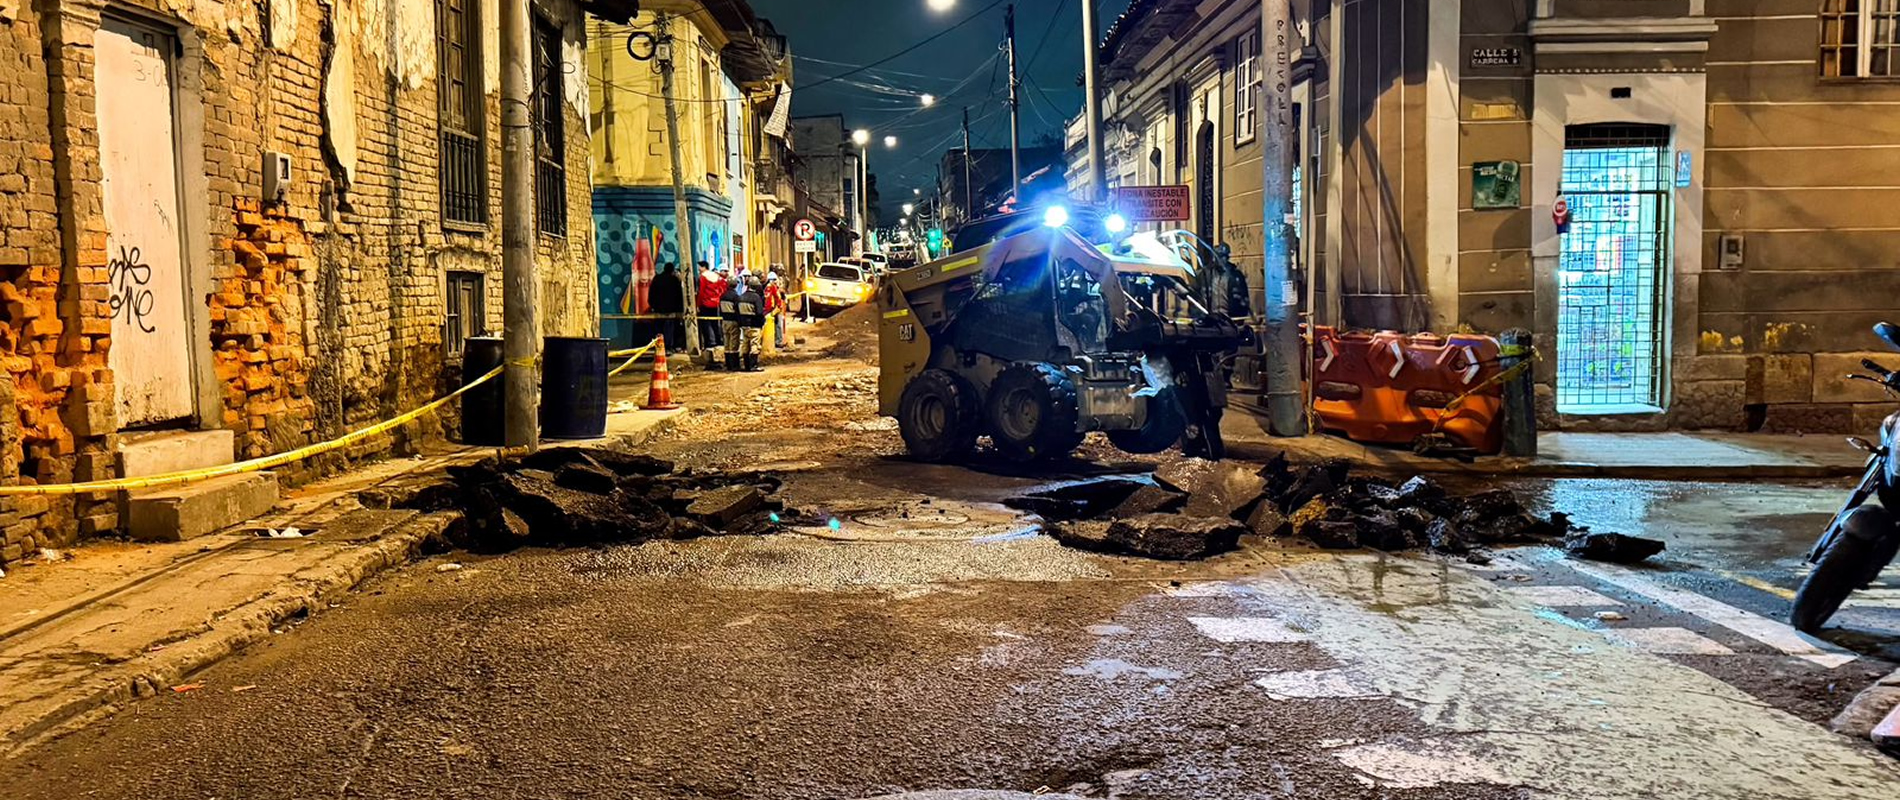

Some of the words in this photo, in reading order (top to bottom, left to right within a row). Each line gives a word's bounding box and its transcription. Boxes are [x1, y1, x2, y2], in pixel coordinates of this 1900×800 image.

[1473, 48, 1508, 57] CALLE
[1121, 189, 1143, 198] ZONA
[1145, 188, 1185, 198] INESTABLE
[1165, 198, 1182, 208] CON
[900, 324, 913, 340] CAT
